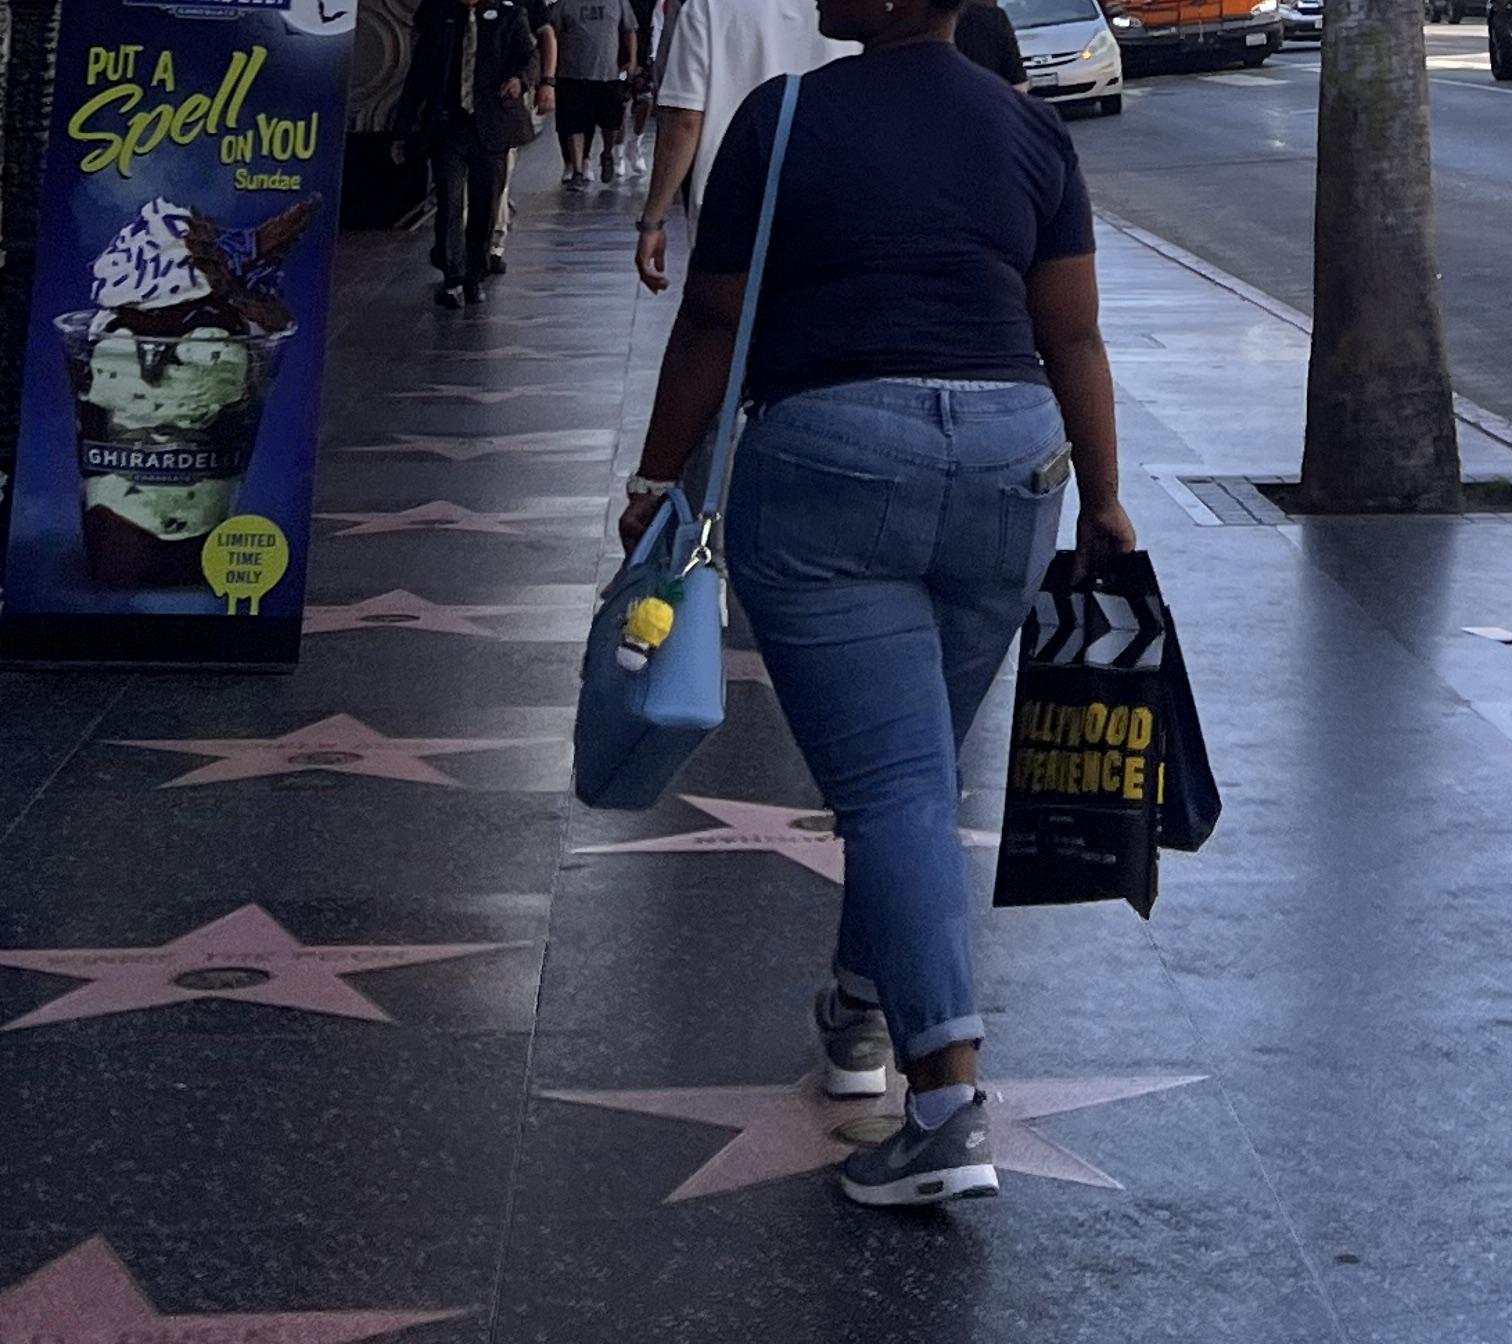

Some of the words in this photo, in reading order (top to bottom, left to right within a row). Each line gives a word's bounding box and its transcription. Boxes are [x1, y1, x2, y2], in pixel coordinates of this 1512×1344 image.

[86, 44, 144, 86] PUT
[150, 50, 175, 92] A
[67, 45, 268, 178] Spell
[221, 130, 255, 164] ON
[257, 112, 319, 160] YOU
[235, 169, 302, 191] Sundae
[216, 533, 276, 547] LIMITED
[228, 551, 262, 566] TIME
[226, 570, 262, 584] ONLY
[1021, 701, 1154, 751] OLLYWOOD
